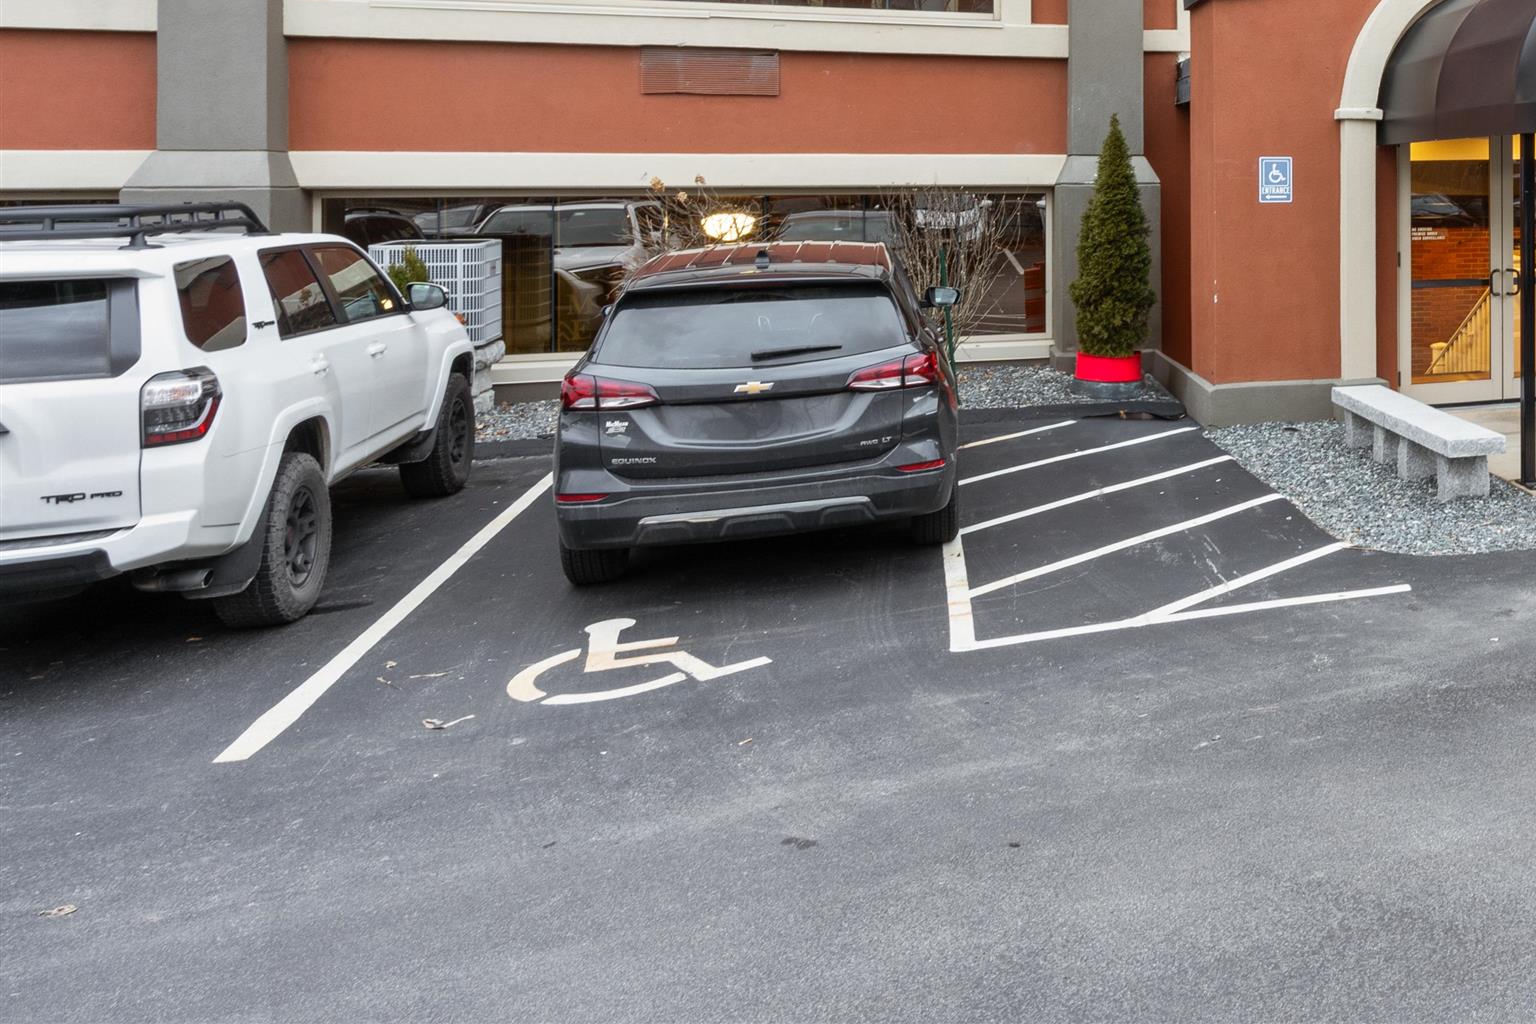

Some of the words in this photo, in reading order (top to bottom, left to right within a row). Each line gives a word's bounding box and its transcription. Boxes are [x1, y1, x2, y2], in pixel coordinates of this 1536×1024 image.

[1262, 186, 1290, 194] ENTRANCE
[881, 435, 893, 444] LT
[611, 457, 657, 465] EQUINOX
[40, 492, 86, 505] TRD
